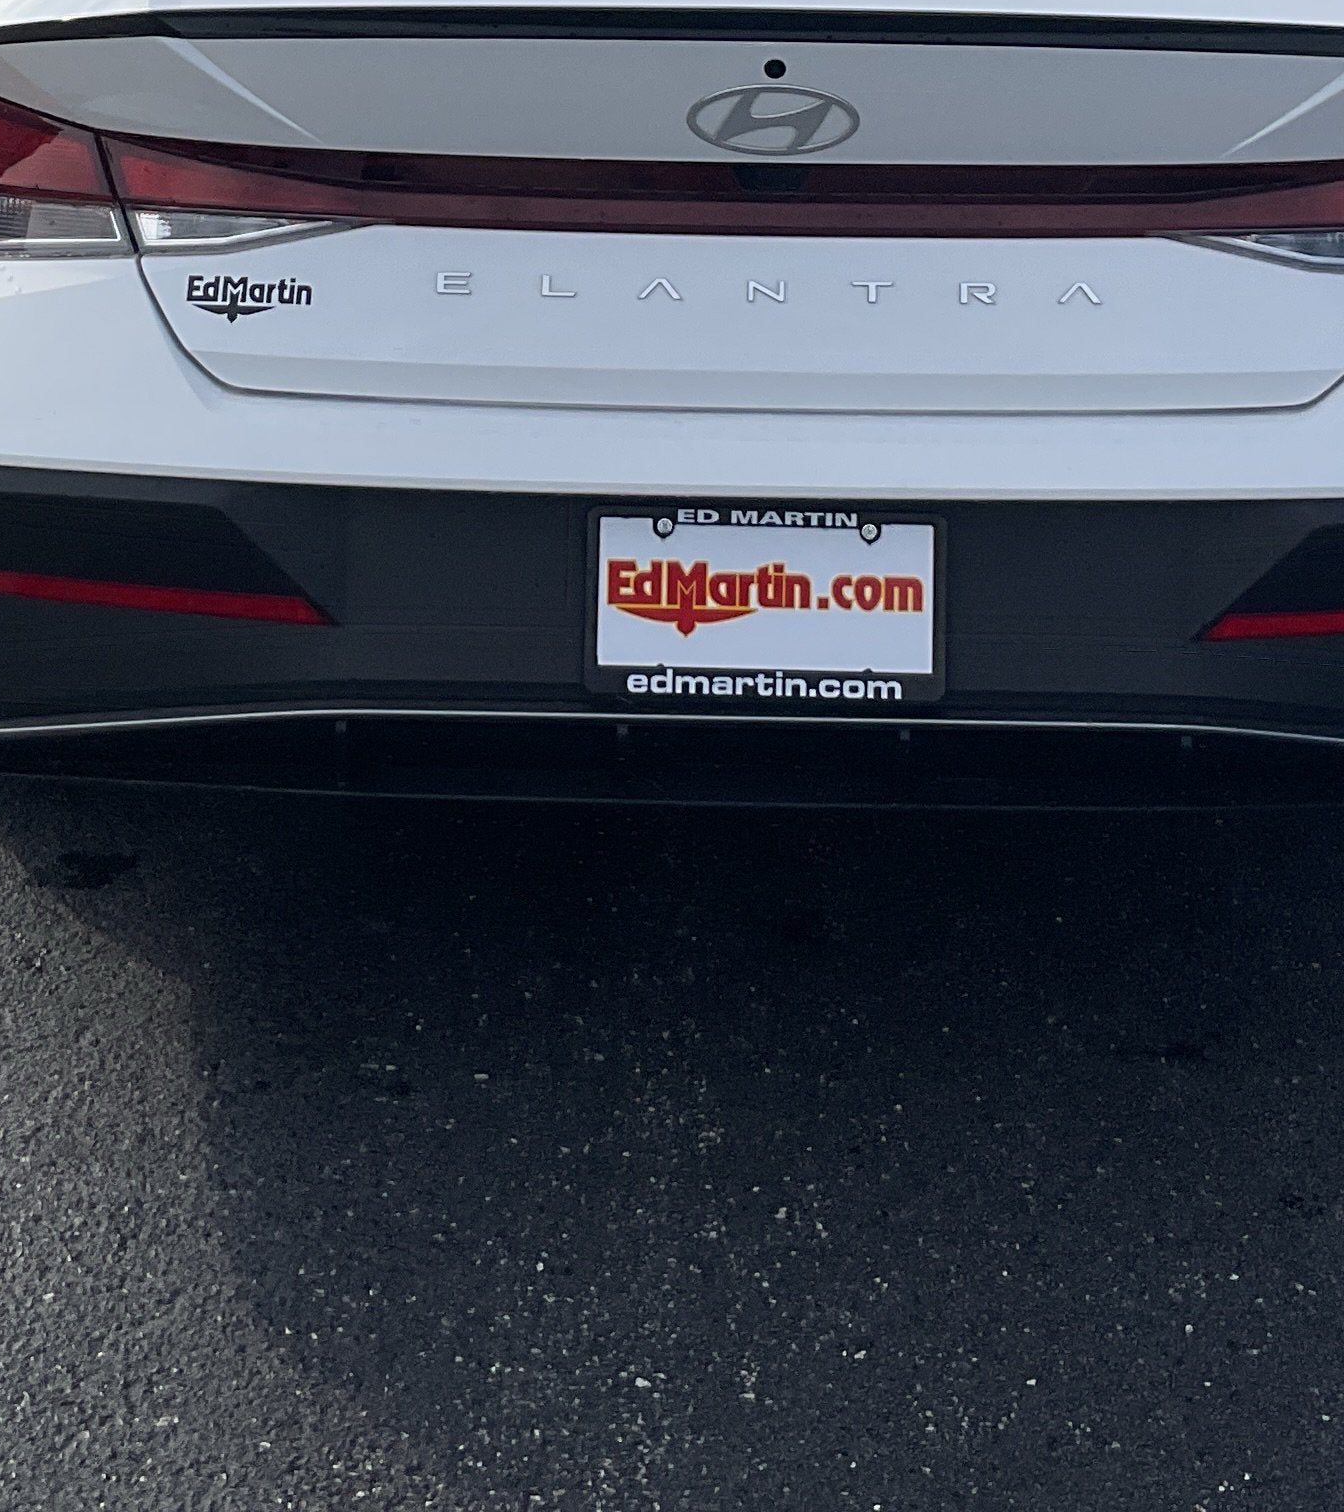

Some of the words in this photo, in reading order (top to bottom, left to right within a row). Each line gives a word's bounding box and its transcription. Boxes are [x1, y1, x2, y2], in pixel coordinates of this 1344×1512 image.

[186, 274, 313, 306] EdMartin
[435, 271, 1102, 305] ELANTRA
[677, 508, 719, 524] ED
[730, 510, 858, 528] MARTIN
[607, 559, 924, 614] EdMartin.com
[626, 668, 903, 701] edmartin.com
